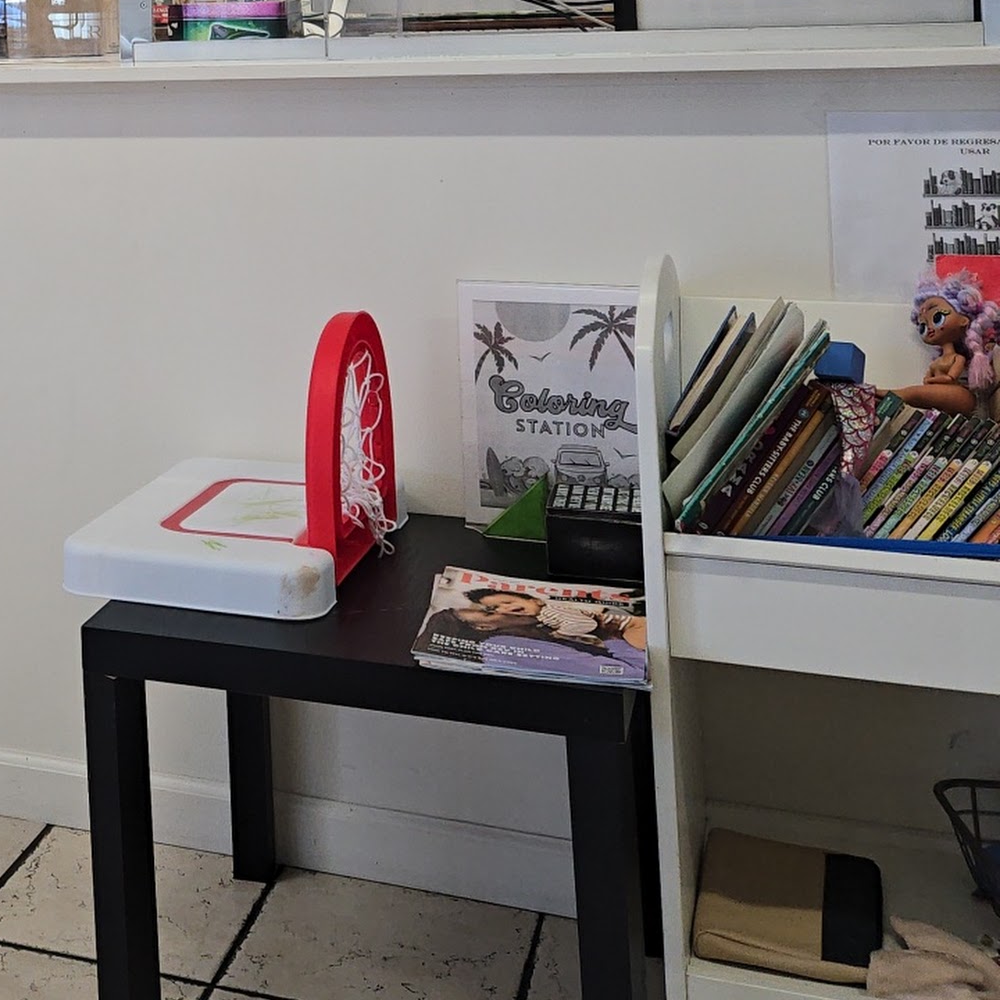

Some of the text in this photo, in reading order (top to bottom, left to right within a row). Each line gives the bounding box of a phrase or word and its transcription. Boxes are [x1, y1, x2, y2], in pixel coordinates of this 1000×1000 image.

[488, 374, 638, 435] Coloring
[516, 418, 605, 439] STATION
[746, 418, 802, 495] THE BABY-SITTERS CLUB
[812, 474, 830, 501] CLUB
